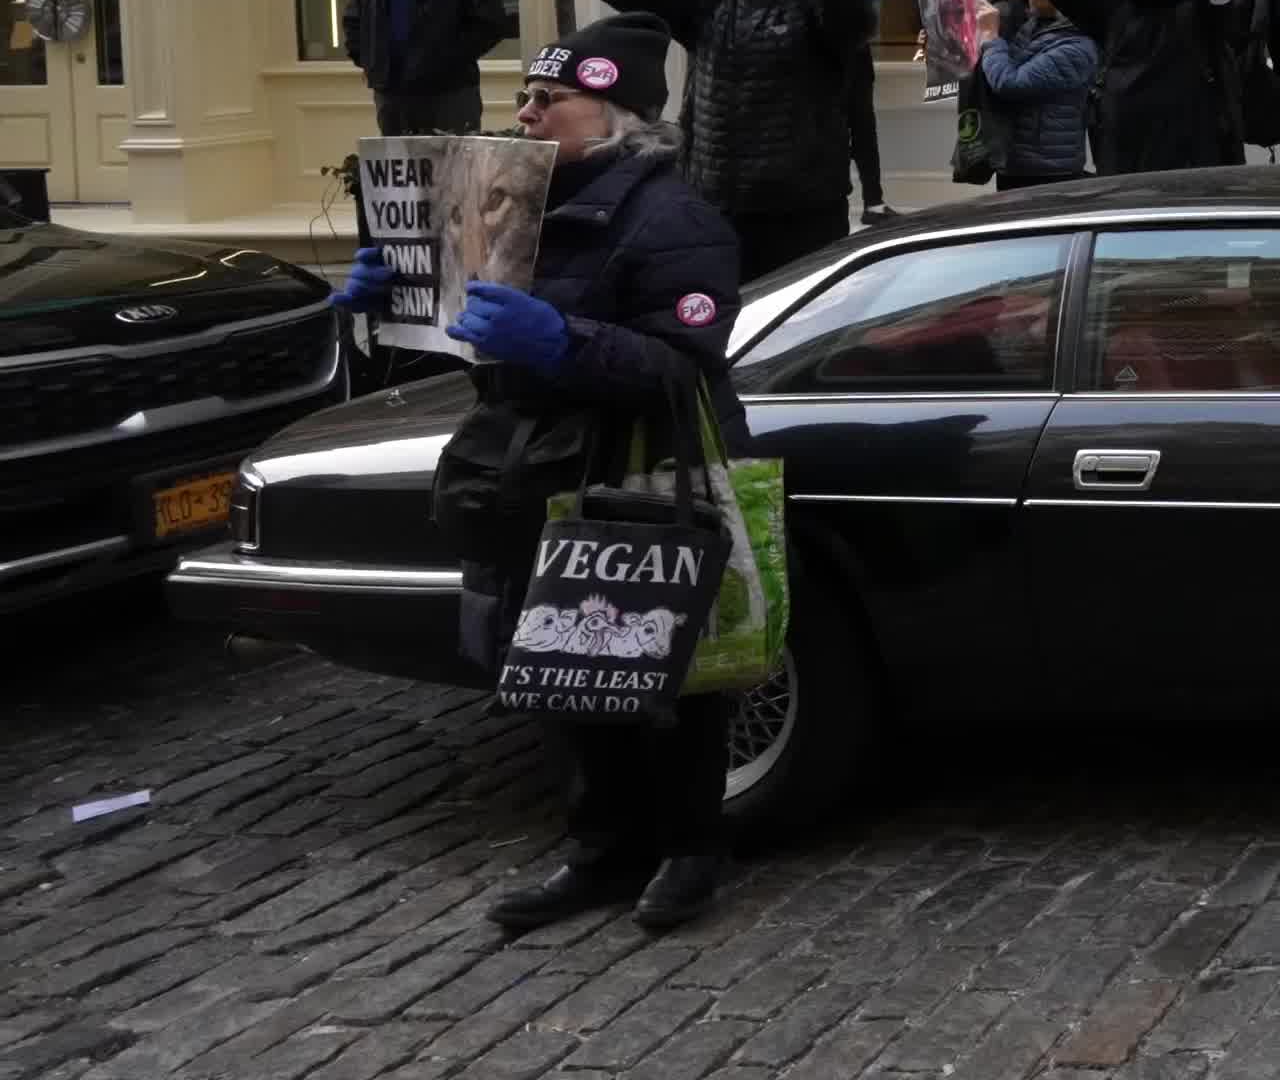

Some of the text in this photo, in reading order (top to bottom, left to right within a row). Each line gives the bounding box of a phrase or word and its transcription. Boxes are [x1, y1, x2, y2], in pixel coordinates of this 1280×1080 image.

[365, 158, 433, 188] WEAR
[372, 200, 431, 230] YOUR
[382, 243, 433, 275] OWN
[391, 286, 434, 318] SKIN
[535, 540, 704, 587] VEGAN
[500, 665, 669, 691] T'S THE LEAST
[501, 691, 641, 713] WE CAN DO
